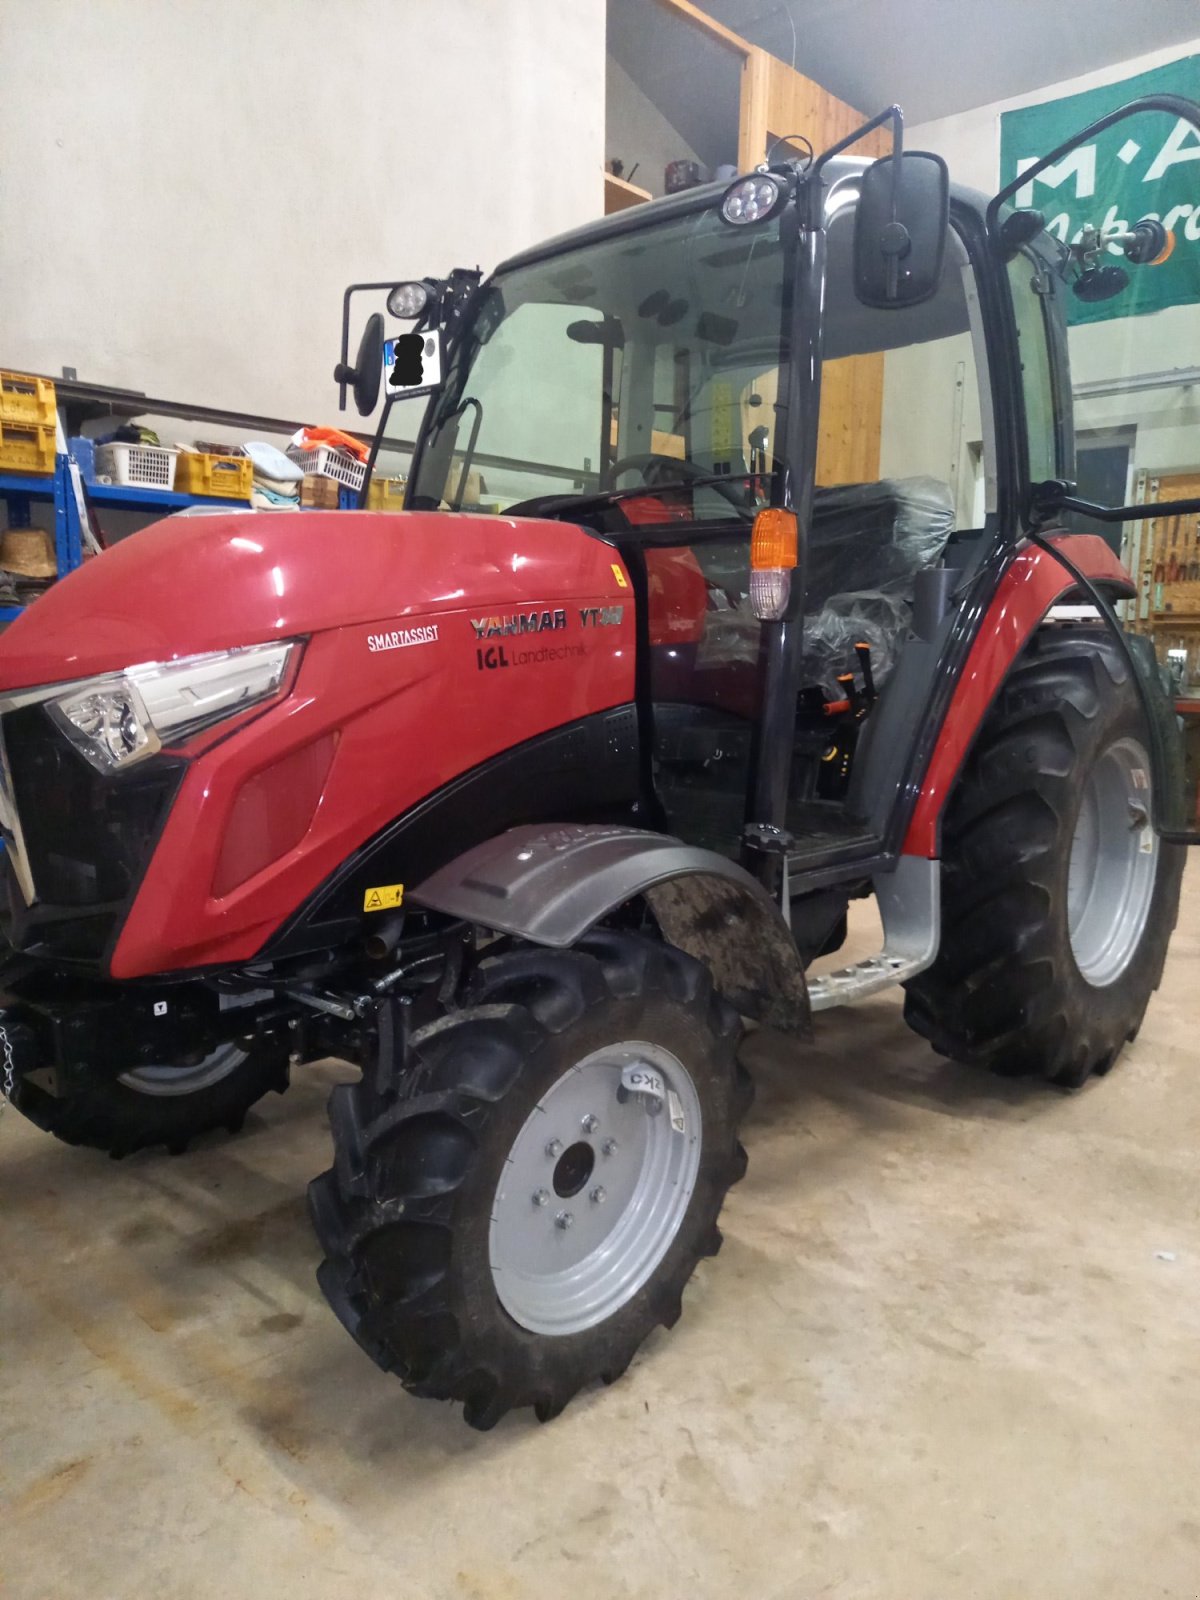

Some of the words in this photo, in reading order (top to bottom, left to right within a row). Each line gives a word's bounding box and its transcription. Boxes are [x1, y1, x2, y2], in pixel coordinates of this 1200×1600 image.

[470, 609, 567, 640] YANMAR
[367, 625, 438, 652] SMARTASSIST
[477, 646, 508, 670] IGL
